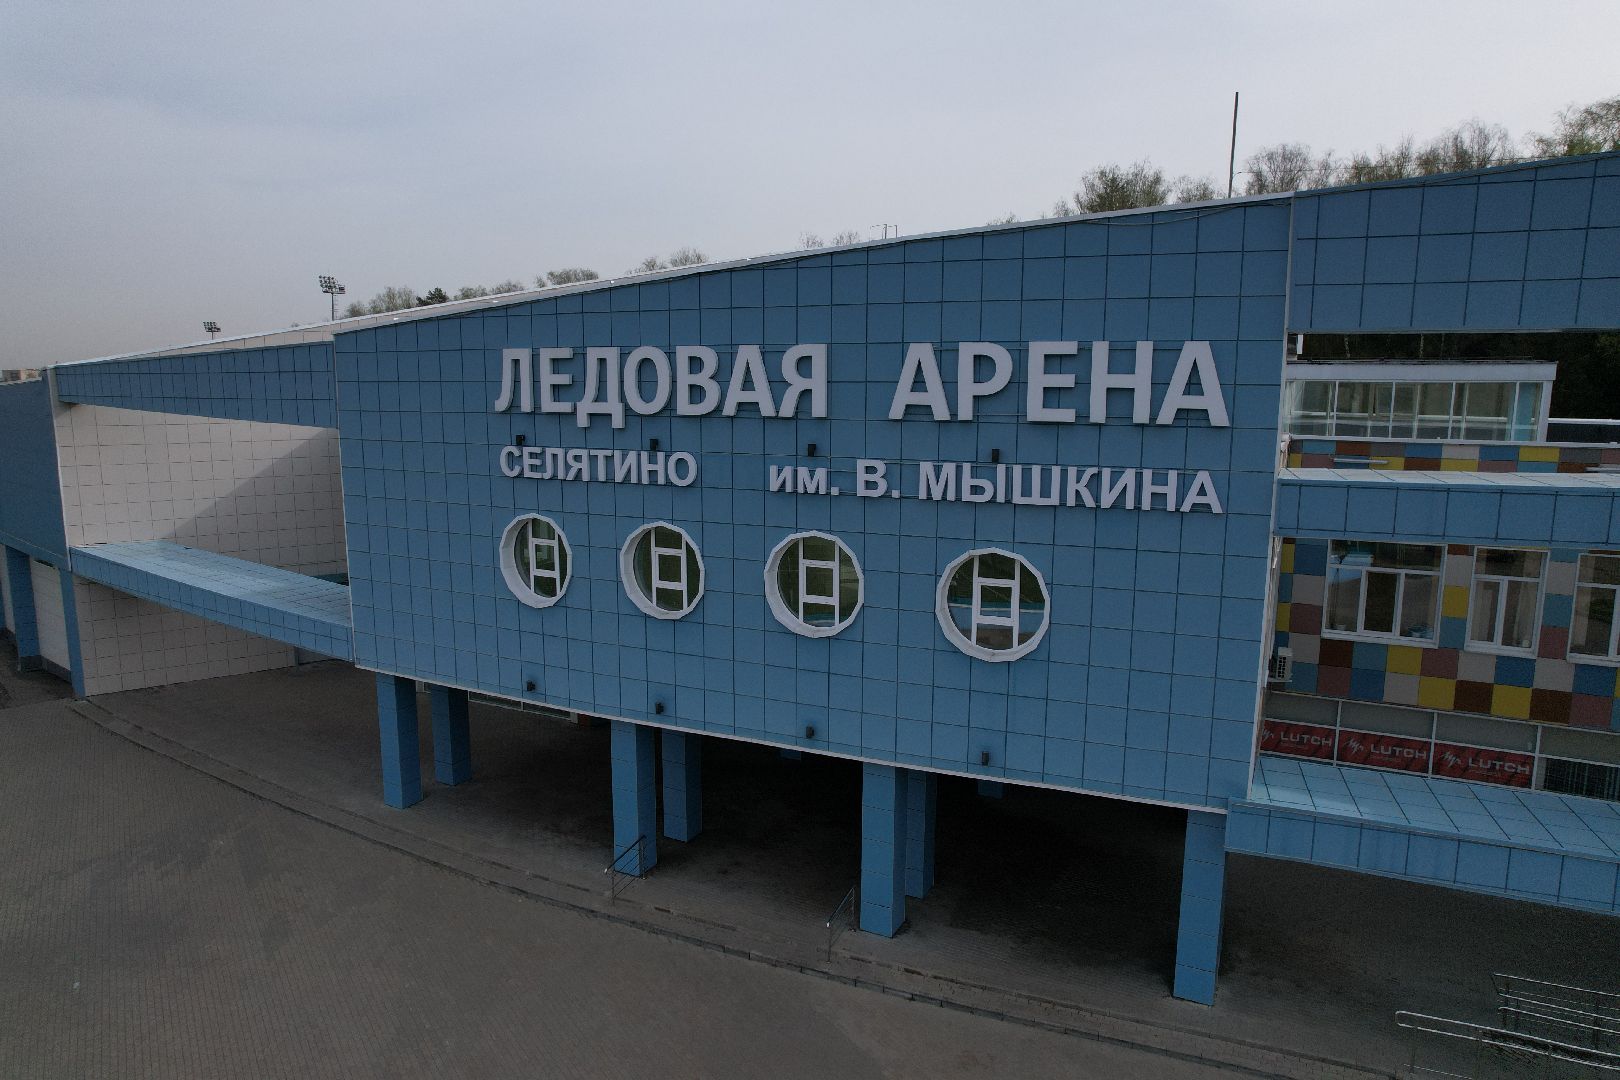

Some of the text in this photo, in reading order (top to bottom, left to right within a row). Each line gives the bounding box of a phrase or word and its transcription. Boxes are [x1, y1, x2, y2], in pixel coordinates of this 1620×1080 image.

[495, 340, 1231, 429] ЛЕДОВАЯ АРЕНА
[499, 445, 1224, 515] СЕЛЯТИНО им. В. МЫШКИНА
[1280, 731, 1333, 747] LUTCH
[1370, 743, 1427, 760] LUTCH
[1468, 756, 1530, 775] LUTCH
